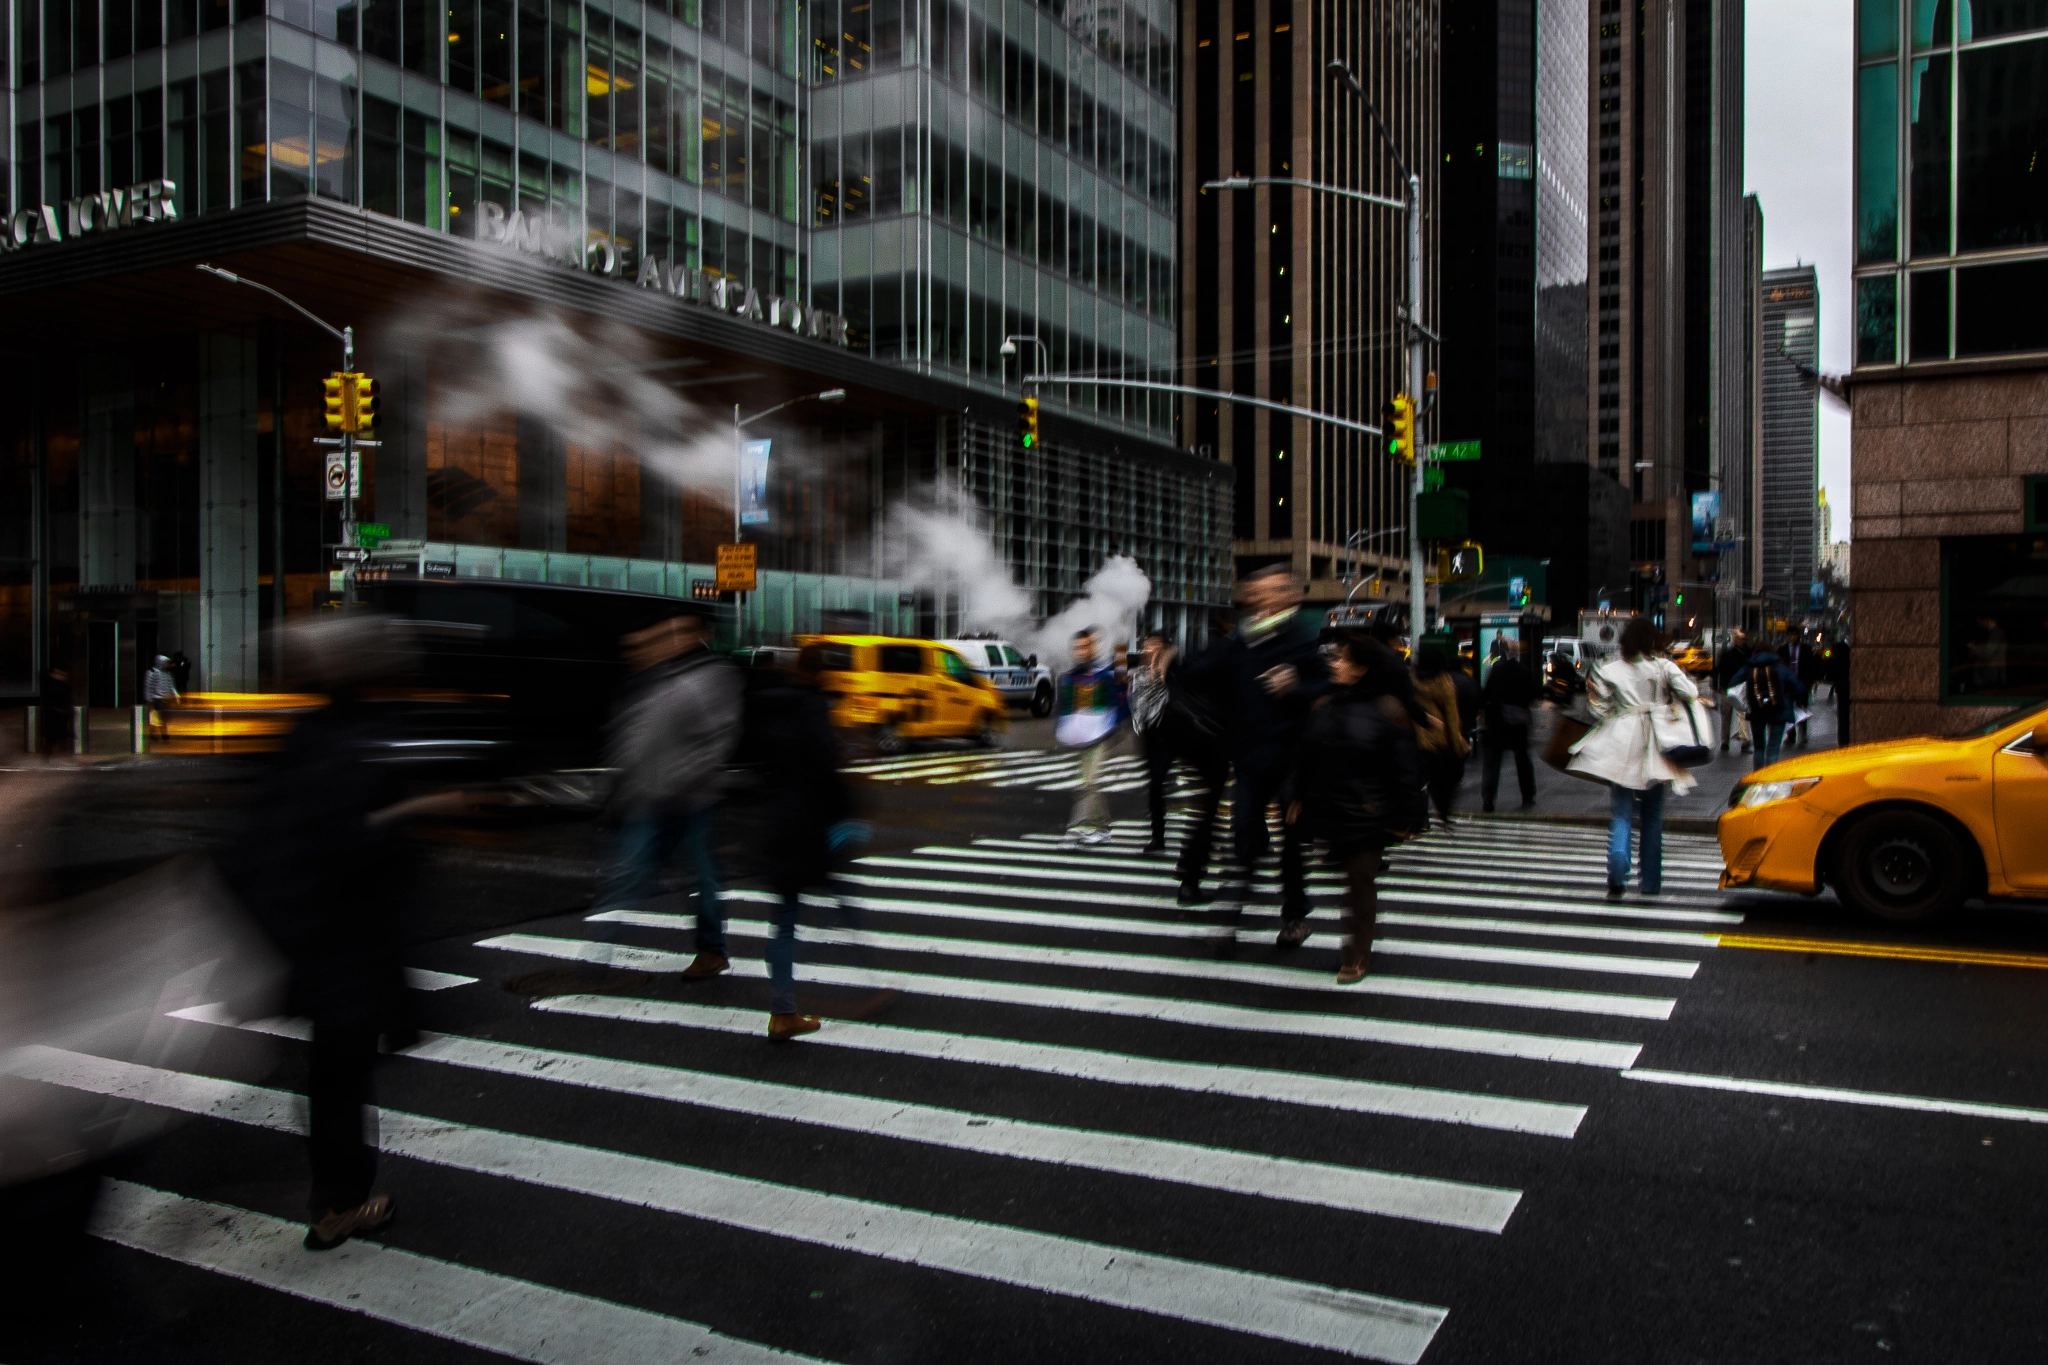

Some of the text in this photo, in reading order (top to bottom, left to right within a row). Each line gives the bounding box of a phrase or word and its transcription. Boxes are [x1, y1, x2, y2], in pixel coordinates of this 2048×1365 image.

[62, 178, 178, 239] TOWER
[586, 238, 633, 278] OF
[635, 253, 764, 322] AMERICA
[766, 293, 849, 347] TOWER
[1452, 443, 1467, 458] 42
[426, 563, 452, 575] Subway
